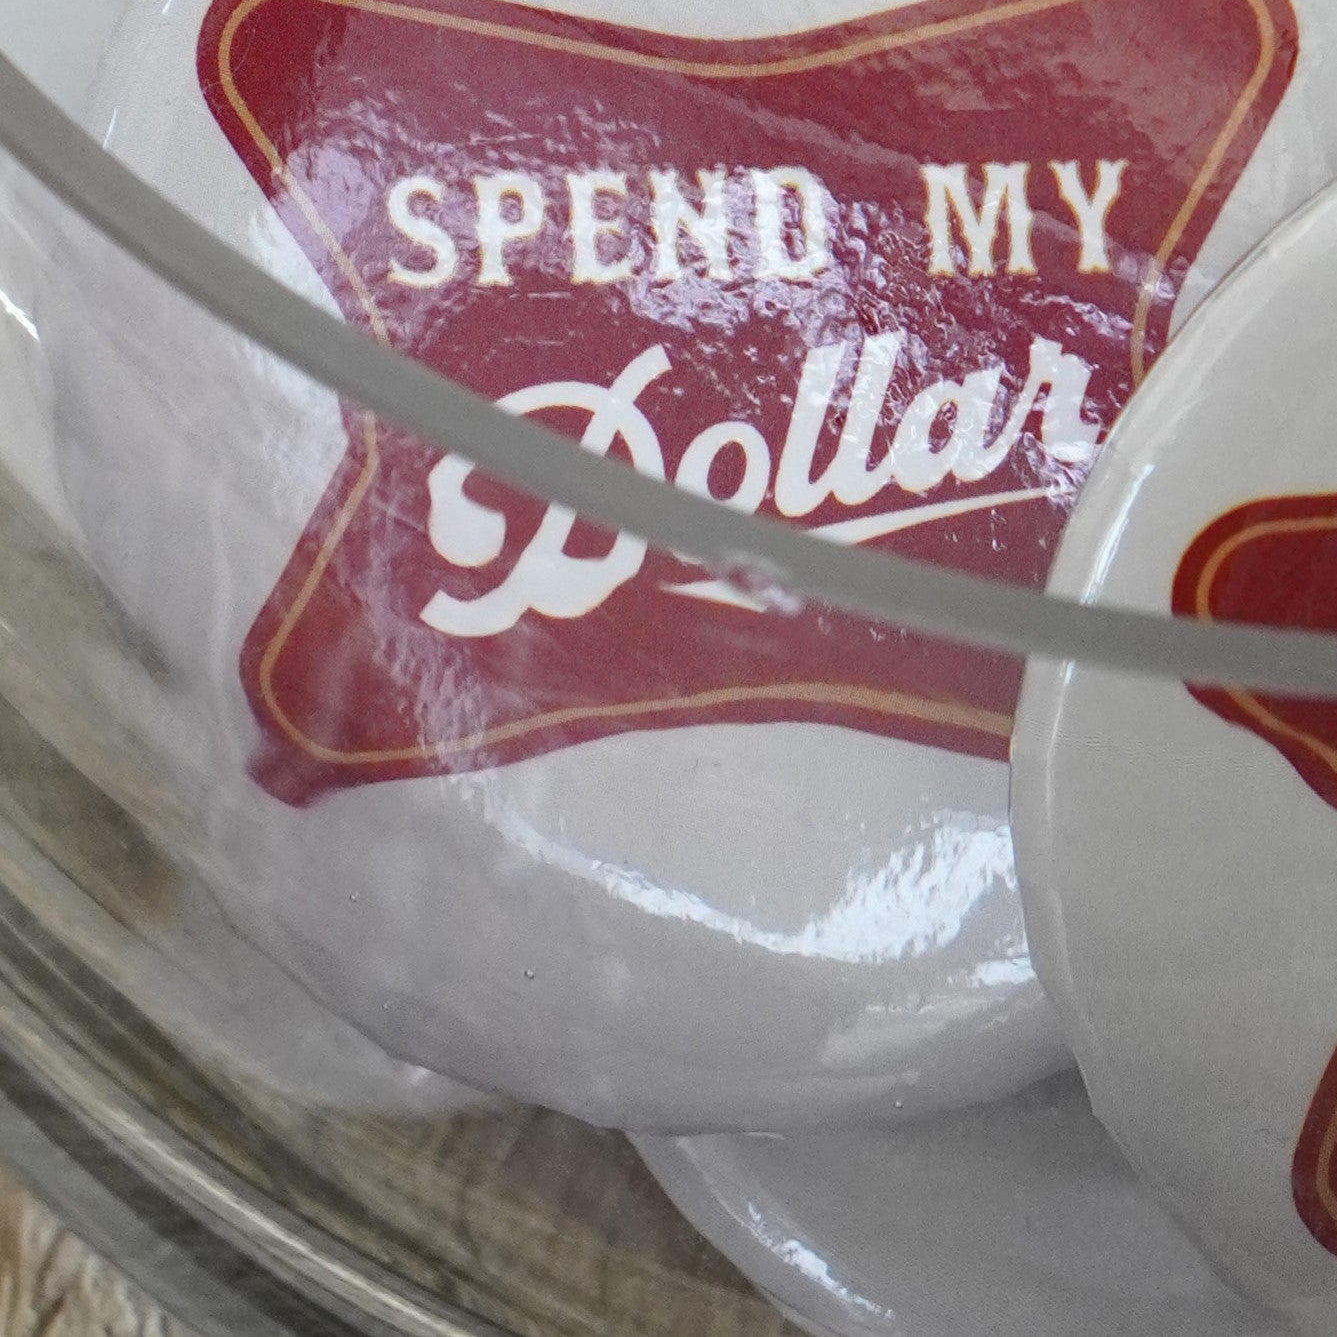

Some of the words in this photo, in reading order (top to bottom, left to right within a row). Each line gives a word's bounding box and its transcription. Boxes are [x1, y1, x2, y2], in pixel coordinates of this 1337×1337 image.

[386, 163, 832, 289] SPEND
[920, 158, 1128, 278] MY
[418, 333, 1105, 638] Dollar
